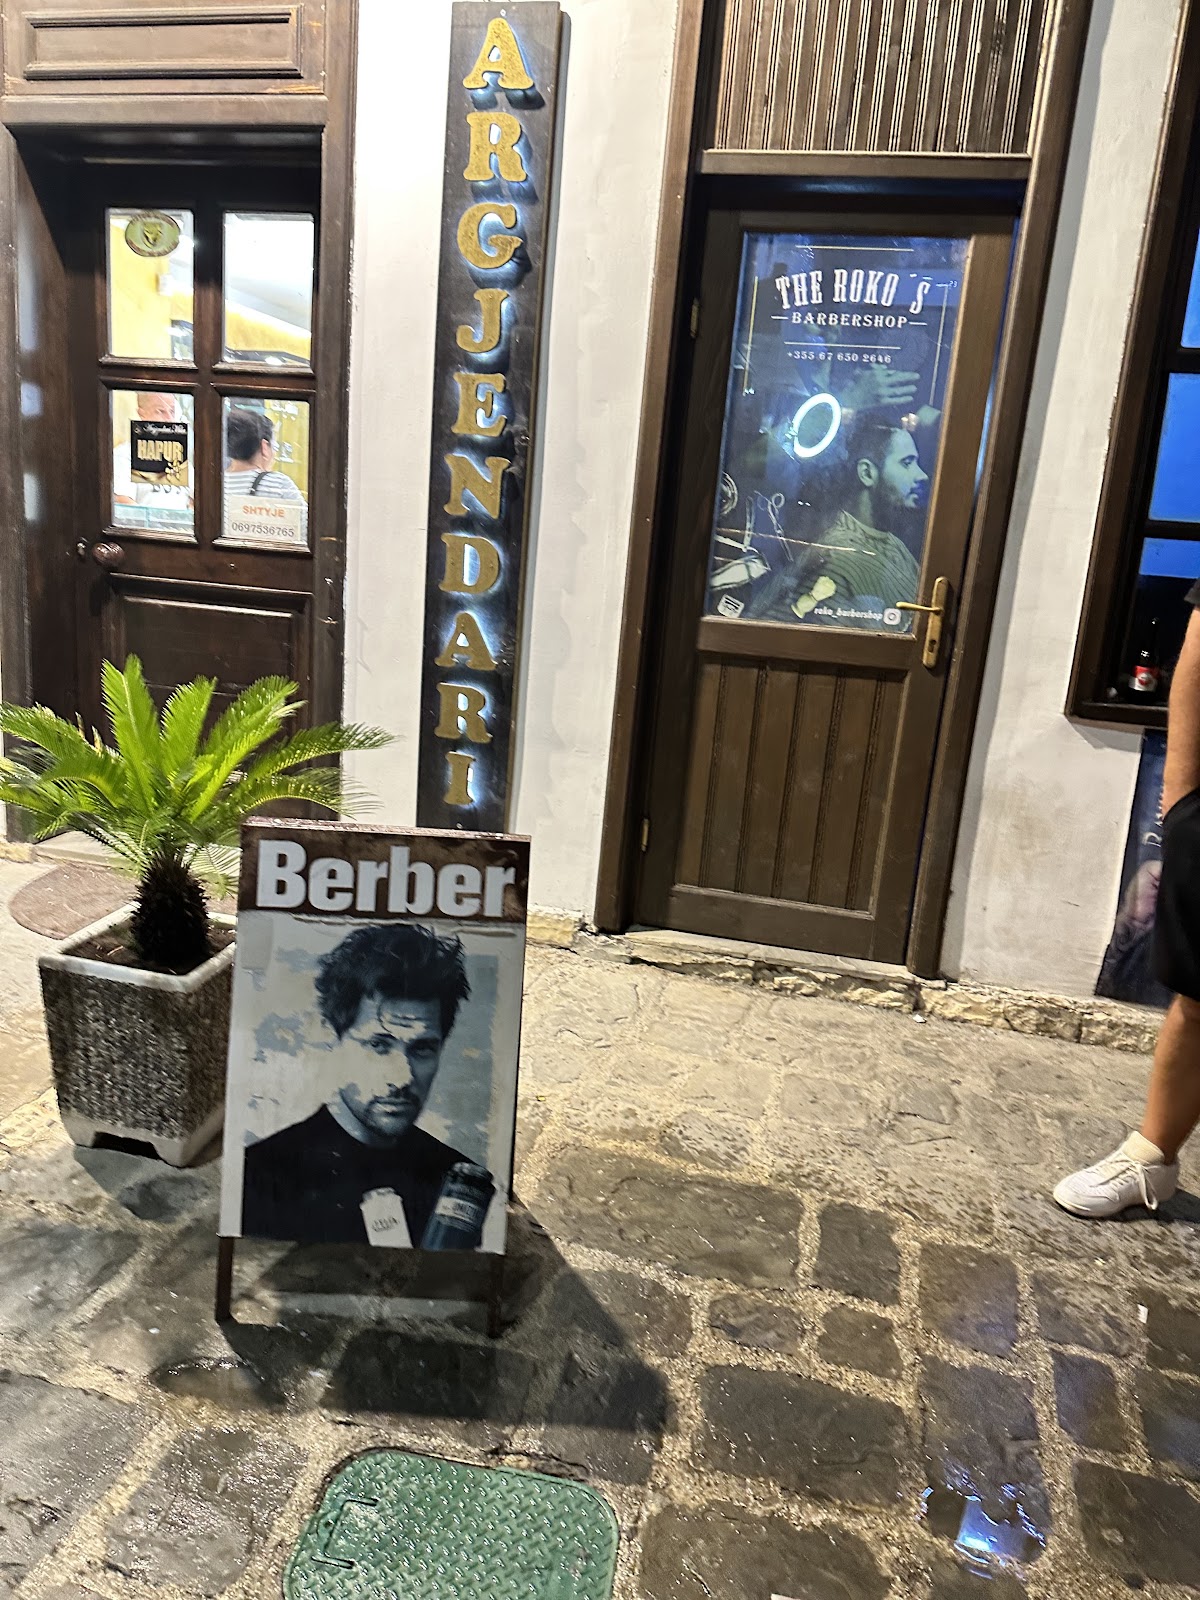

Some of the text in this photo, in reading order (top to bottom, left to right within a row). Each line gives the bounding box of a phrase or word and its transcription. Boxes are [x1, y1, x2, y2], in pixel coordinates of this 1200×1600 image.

[775, 270, 823, 309] THE
[833, 268, 900, 307] ROKO
[791, 311, 908, 328] BARBERSHOP
[818, 351, 834, 361] 67
[837, 352, 859, 362] 650
[434, 17, 535, 805] ARGJENDARI
[137, 439, 184, 463] HAPUR
[242, 505, 286, 518] SHTYJE
[256, 839, 516, 918] Berber
